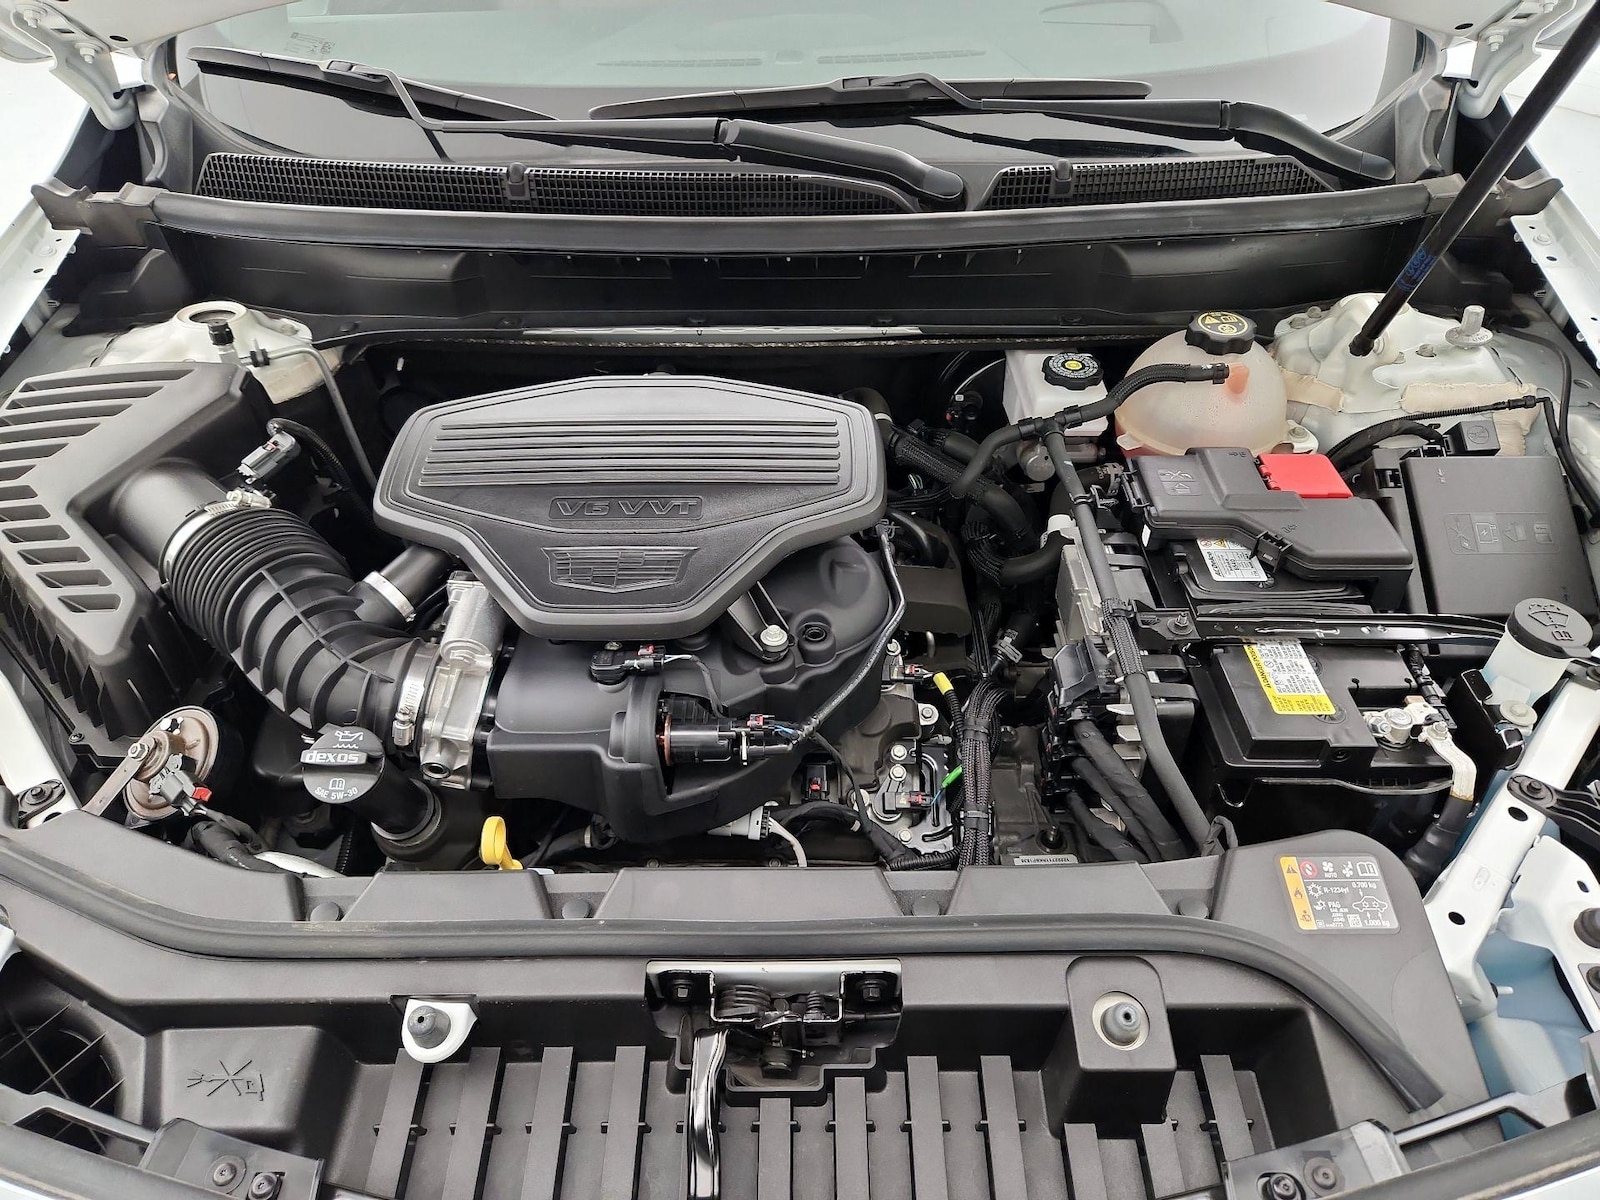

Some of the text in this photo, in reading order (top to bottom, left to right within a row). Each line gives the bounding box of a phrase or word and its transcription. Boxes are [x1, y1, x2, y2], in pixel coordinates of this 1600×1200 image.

[556, 501, 698, 516] V6 VVT
[305, 750, 359, 763] dexos
[315, 786, 358, 800] SAE 5W-30
[1382, 919, 1391, 927] kg
